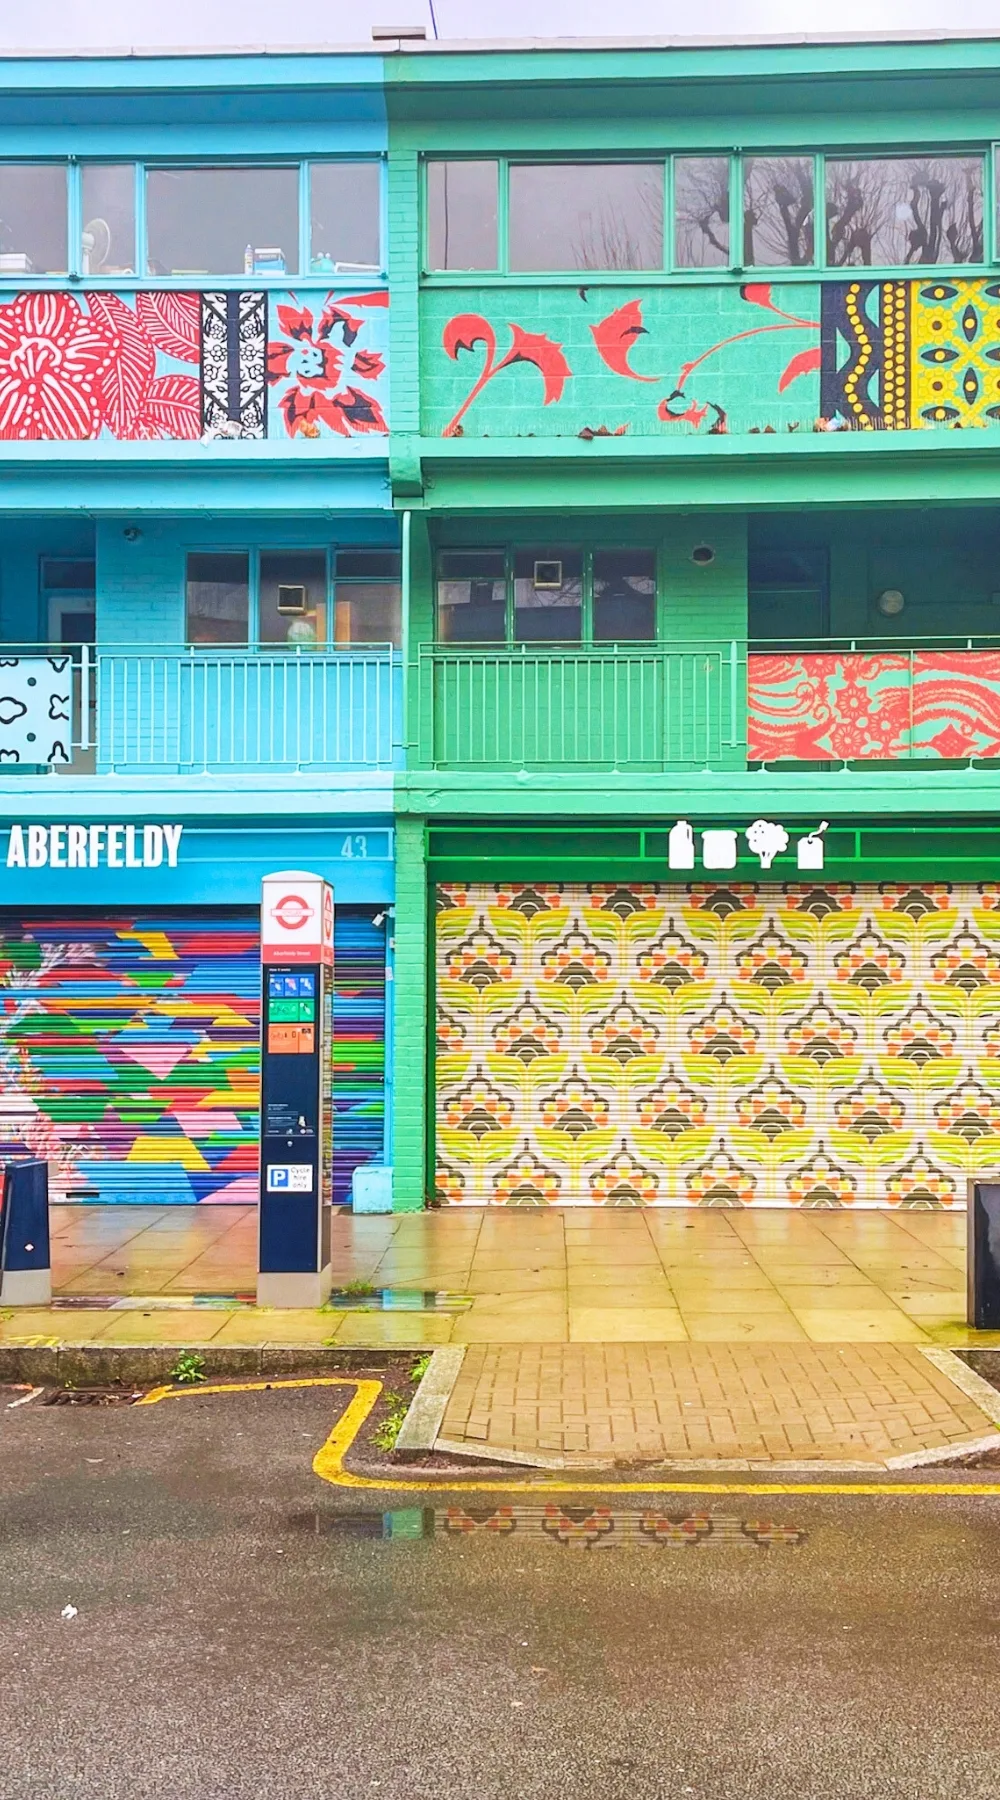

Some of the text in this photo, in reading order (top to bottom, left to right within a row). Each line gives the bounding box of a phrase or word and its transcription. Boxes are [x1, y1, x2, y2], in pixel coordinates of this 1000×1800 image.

[6, 824, 183, 868] ABERFELDY
[341, 835, 367, 859] 43
[273, 1170, 286, 1186] P
